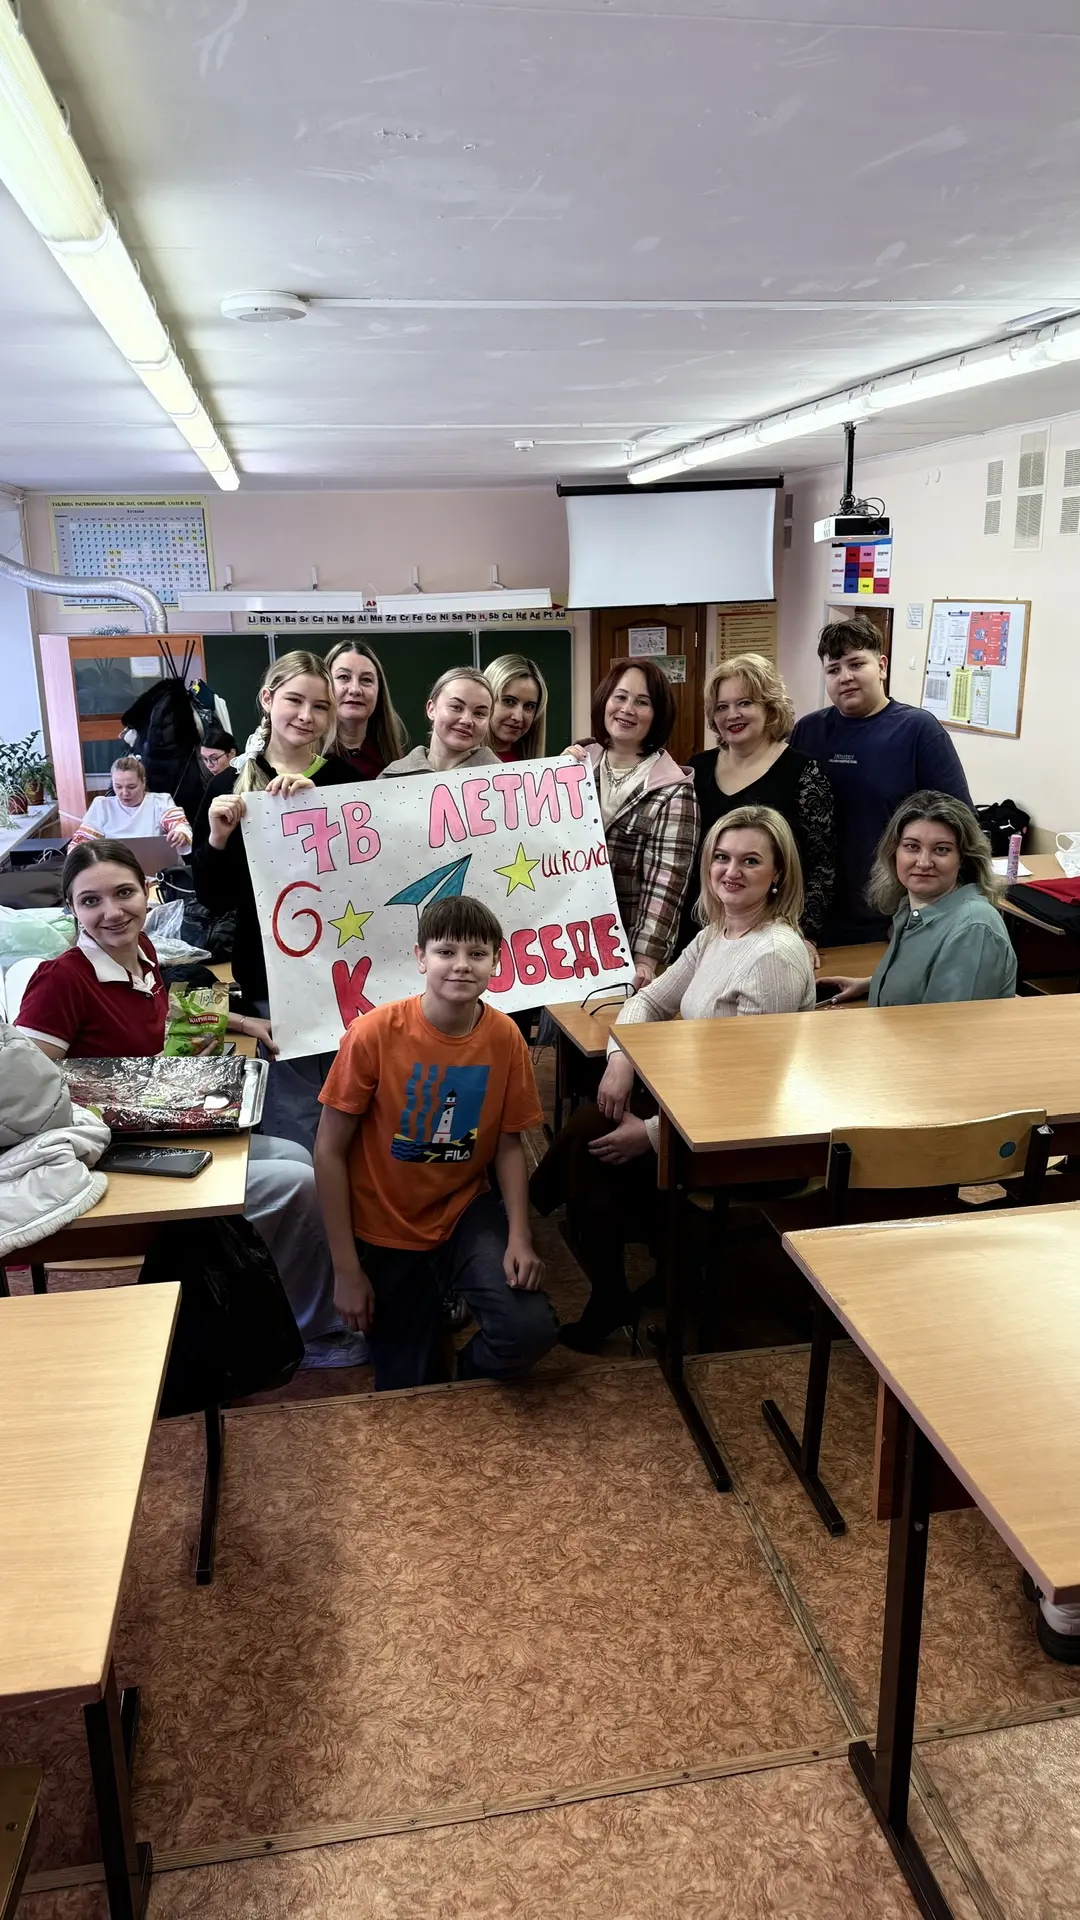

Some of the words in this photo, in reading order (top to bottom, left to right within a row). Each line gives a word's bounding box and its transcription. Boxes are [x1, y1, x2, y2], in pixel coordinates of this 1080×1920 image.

[280, 801, 382, 875] 7В
[428, 764, 587, 848] ЛЕТИТ
[272, 880, 324, 958] 6
[540, 841, 610, 878] школа
[332, 956, 376, 1031] К
[486, 914, 625, 993] ОБЕДЕ
[444, 1150, 471, 1160] FILA
